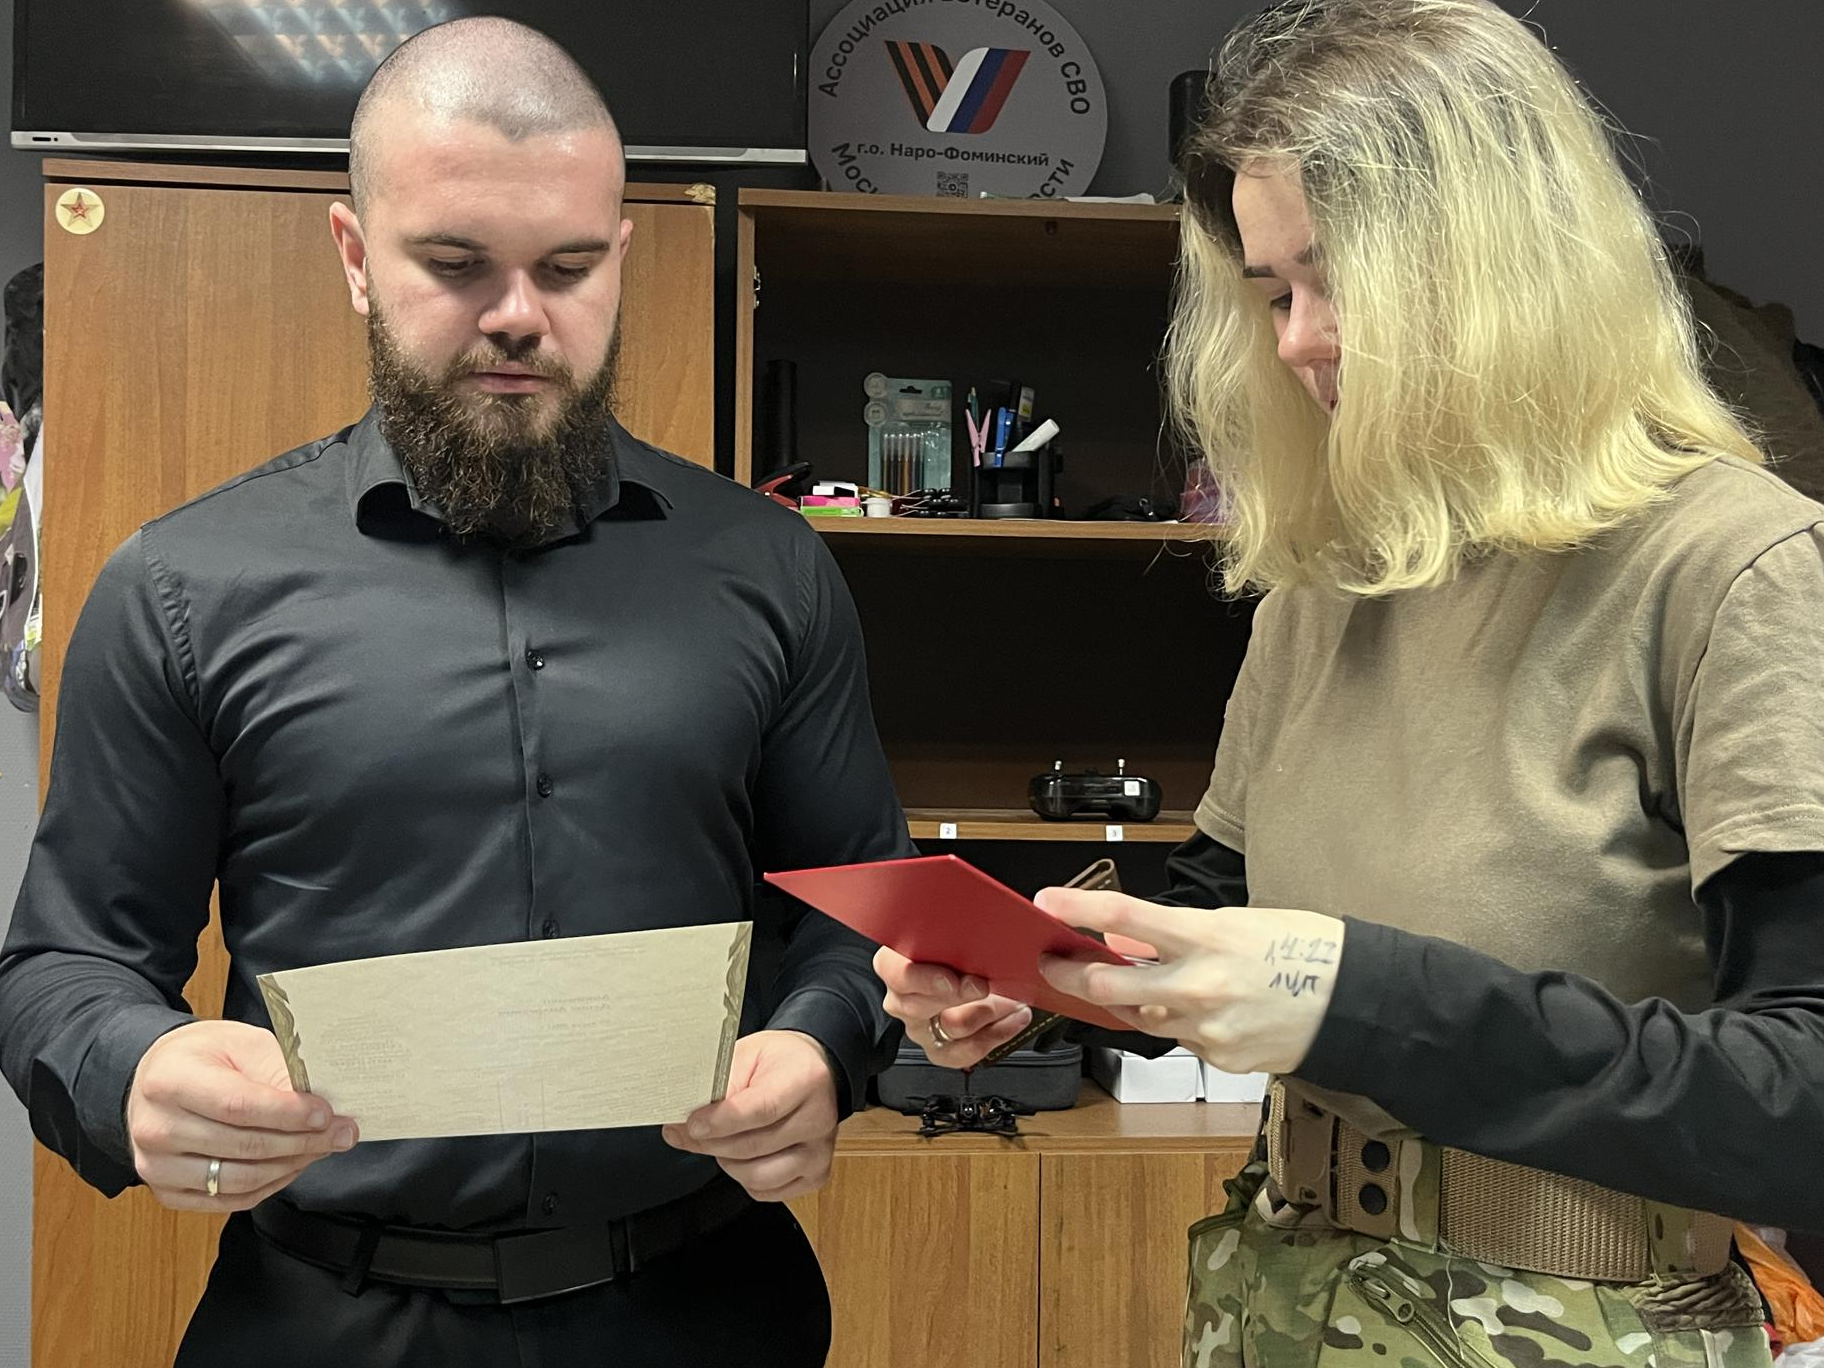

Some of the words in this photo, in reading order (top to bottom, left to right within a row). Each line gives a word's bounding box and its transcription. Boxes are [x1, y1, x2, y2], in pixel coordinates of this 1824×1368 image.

[1061, 61, 1090, 114] СВО
[857, 142, 884, 155] г.о.
[890, 142, 1050, 167] Наро-Фоминский
